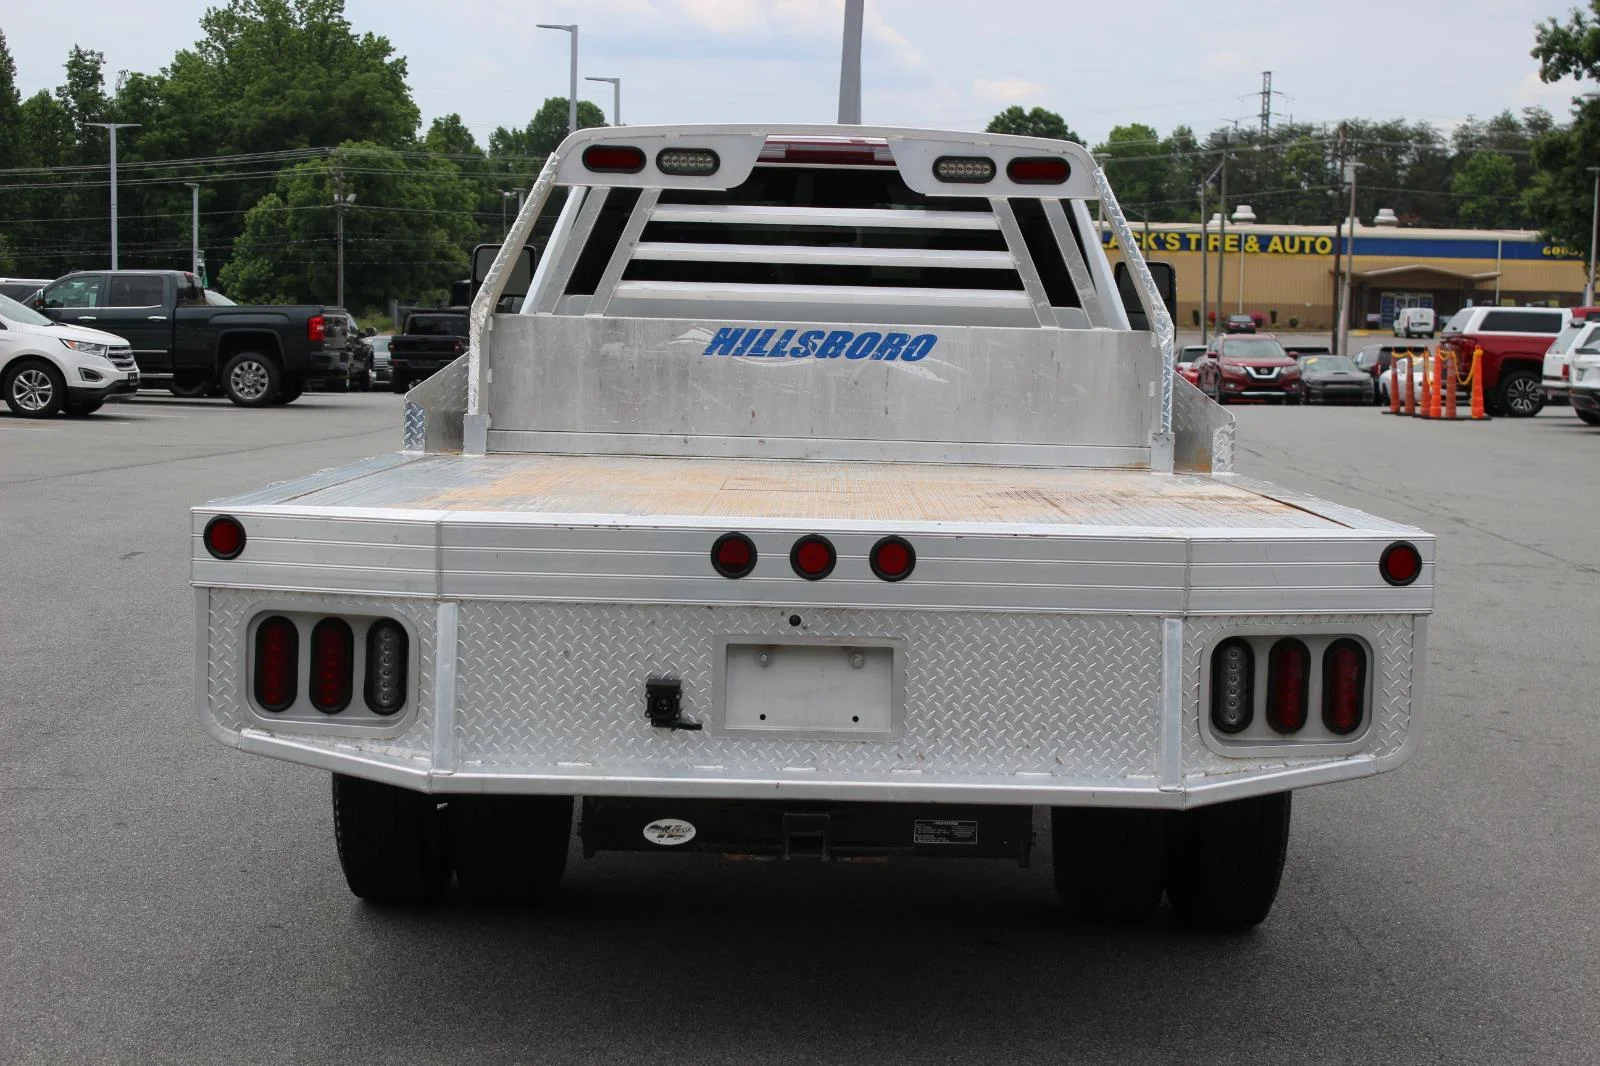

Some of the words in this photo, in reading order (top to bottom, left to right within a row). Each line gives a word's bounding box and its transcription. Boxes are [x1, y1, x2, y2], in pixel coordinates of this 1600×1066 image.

[1186, 232, 1239, 252] TRE
[1244, 235, 1260, 253] &
[1267, 235, 1333, 255] AUTO
[702, 327, 938, 362] HILLSBORO
